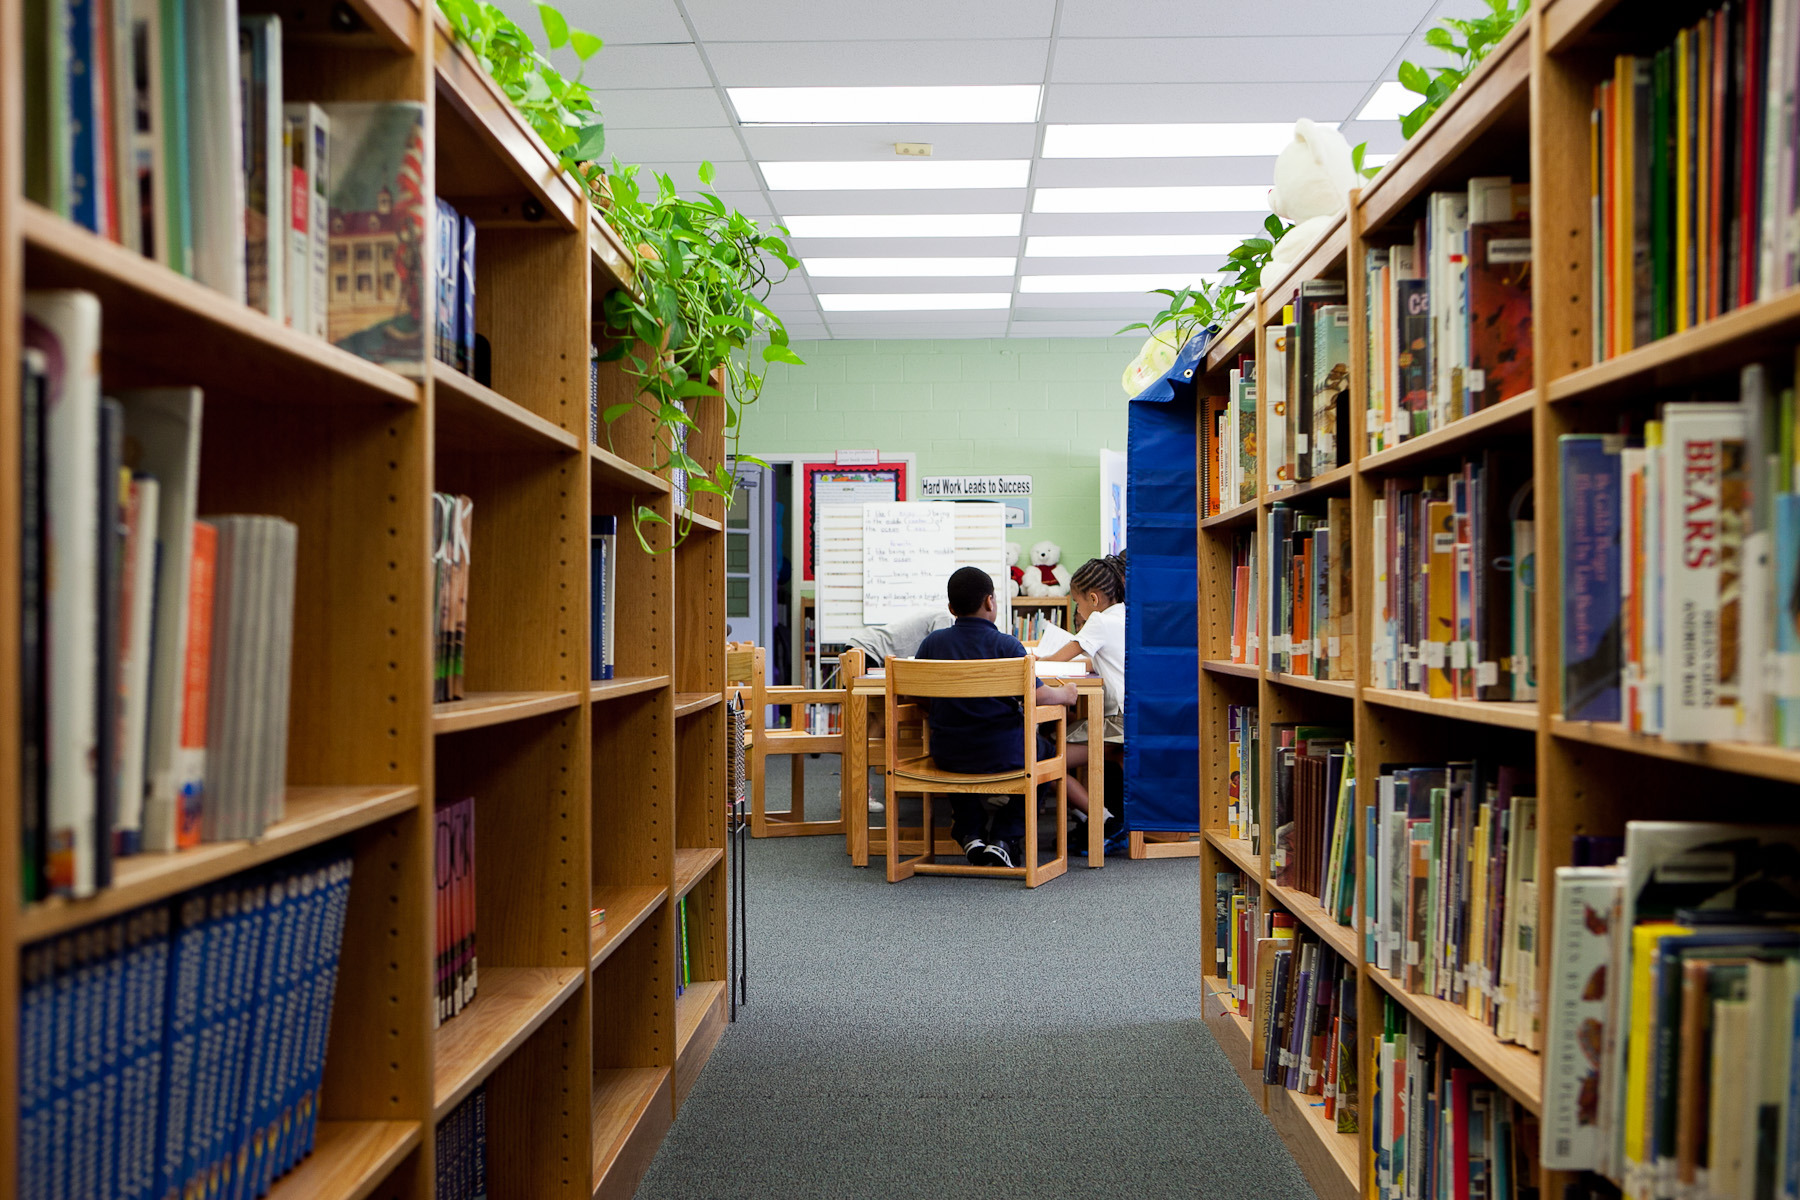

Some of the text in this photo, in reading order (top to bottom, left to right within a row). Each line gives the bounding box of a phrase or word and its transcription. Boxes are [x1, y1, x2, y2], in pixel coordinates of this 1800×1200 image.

[922, 478, 1031, 494] Hard Work Leads to Success
[1682, 439, 1716, 570] BEARS
[1264, 991, 1272, 1014] Rose
[476, 1137, 484, 1193] English
